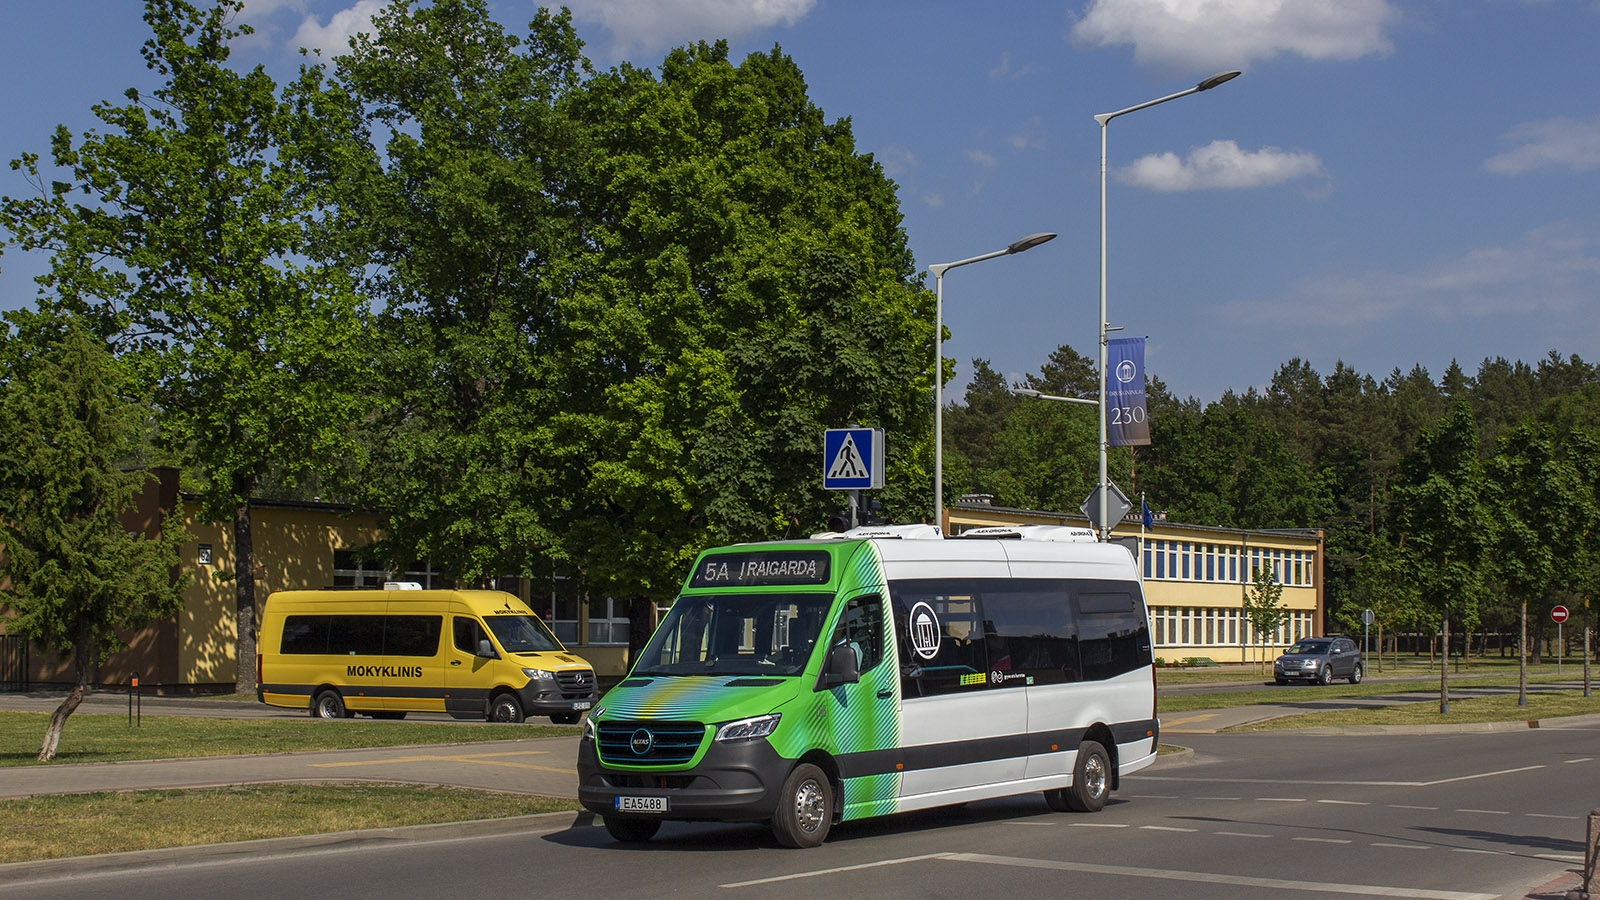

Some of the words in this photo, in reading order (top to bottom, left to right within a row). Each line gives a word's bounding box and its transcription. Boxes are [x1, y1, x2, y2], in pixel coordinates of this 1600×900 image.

[1111, 406, 1145, 425] 230
[704, 562, 729, 581] 5A
[747, 560, 817, 579] RAIGARDĄ
[347, 665, 423, 678] MOKYKLINIS
[624, 798, 662, 809] EA5488
